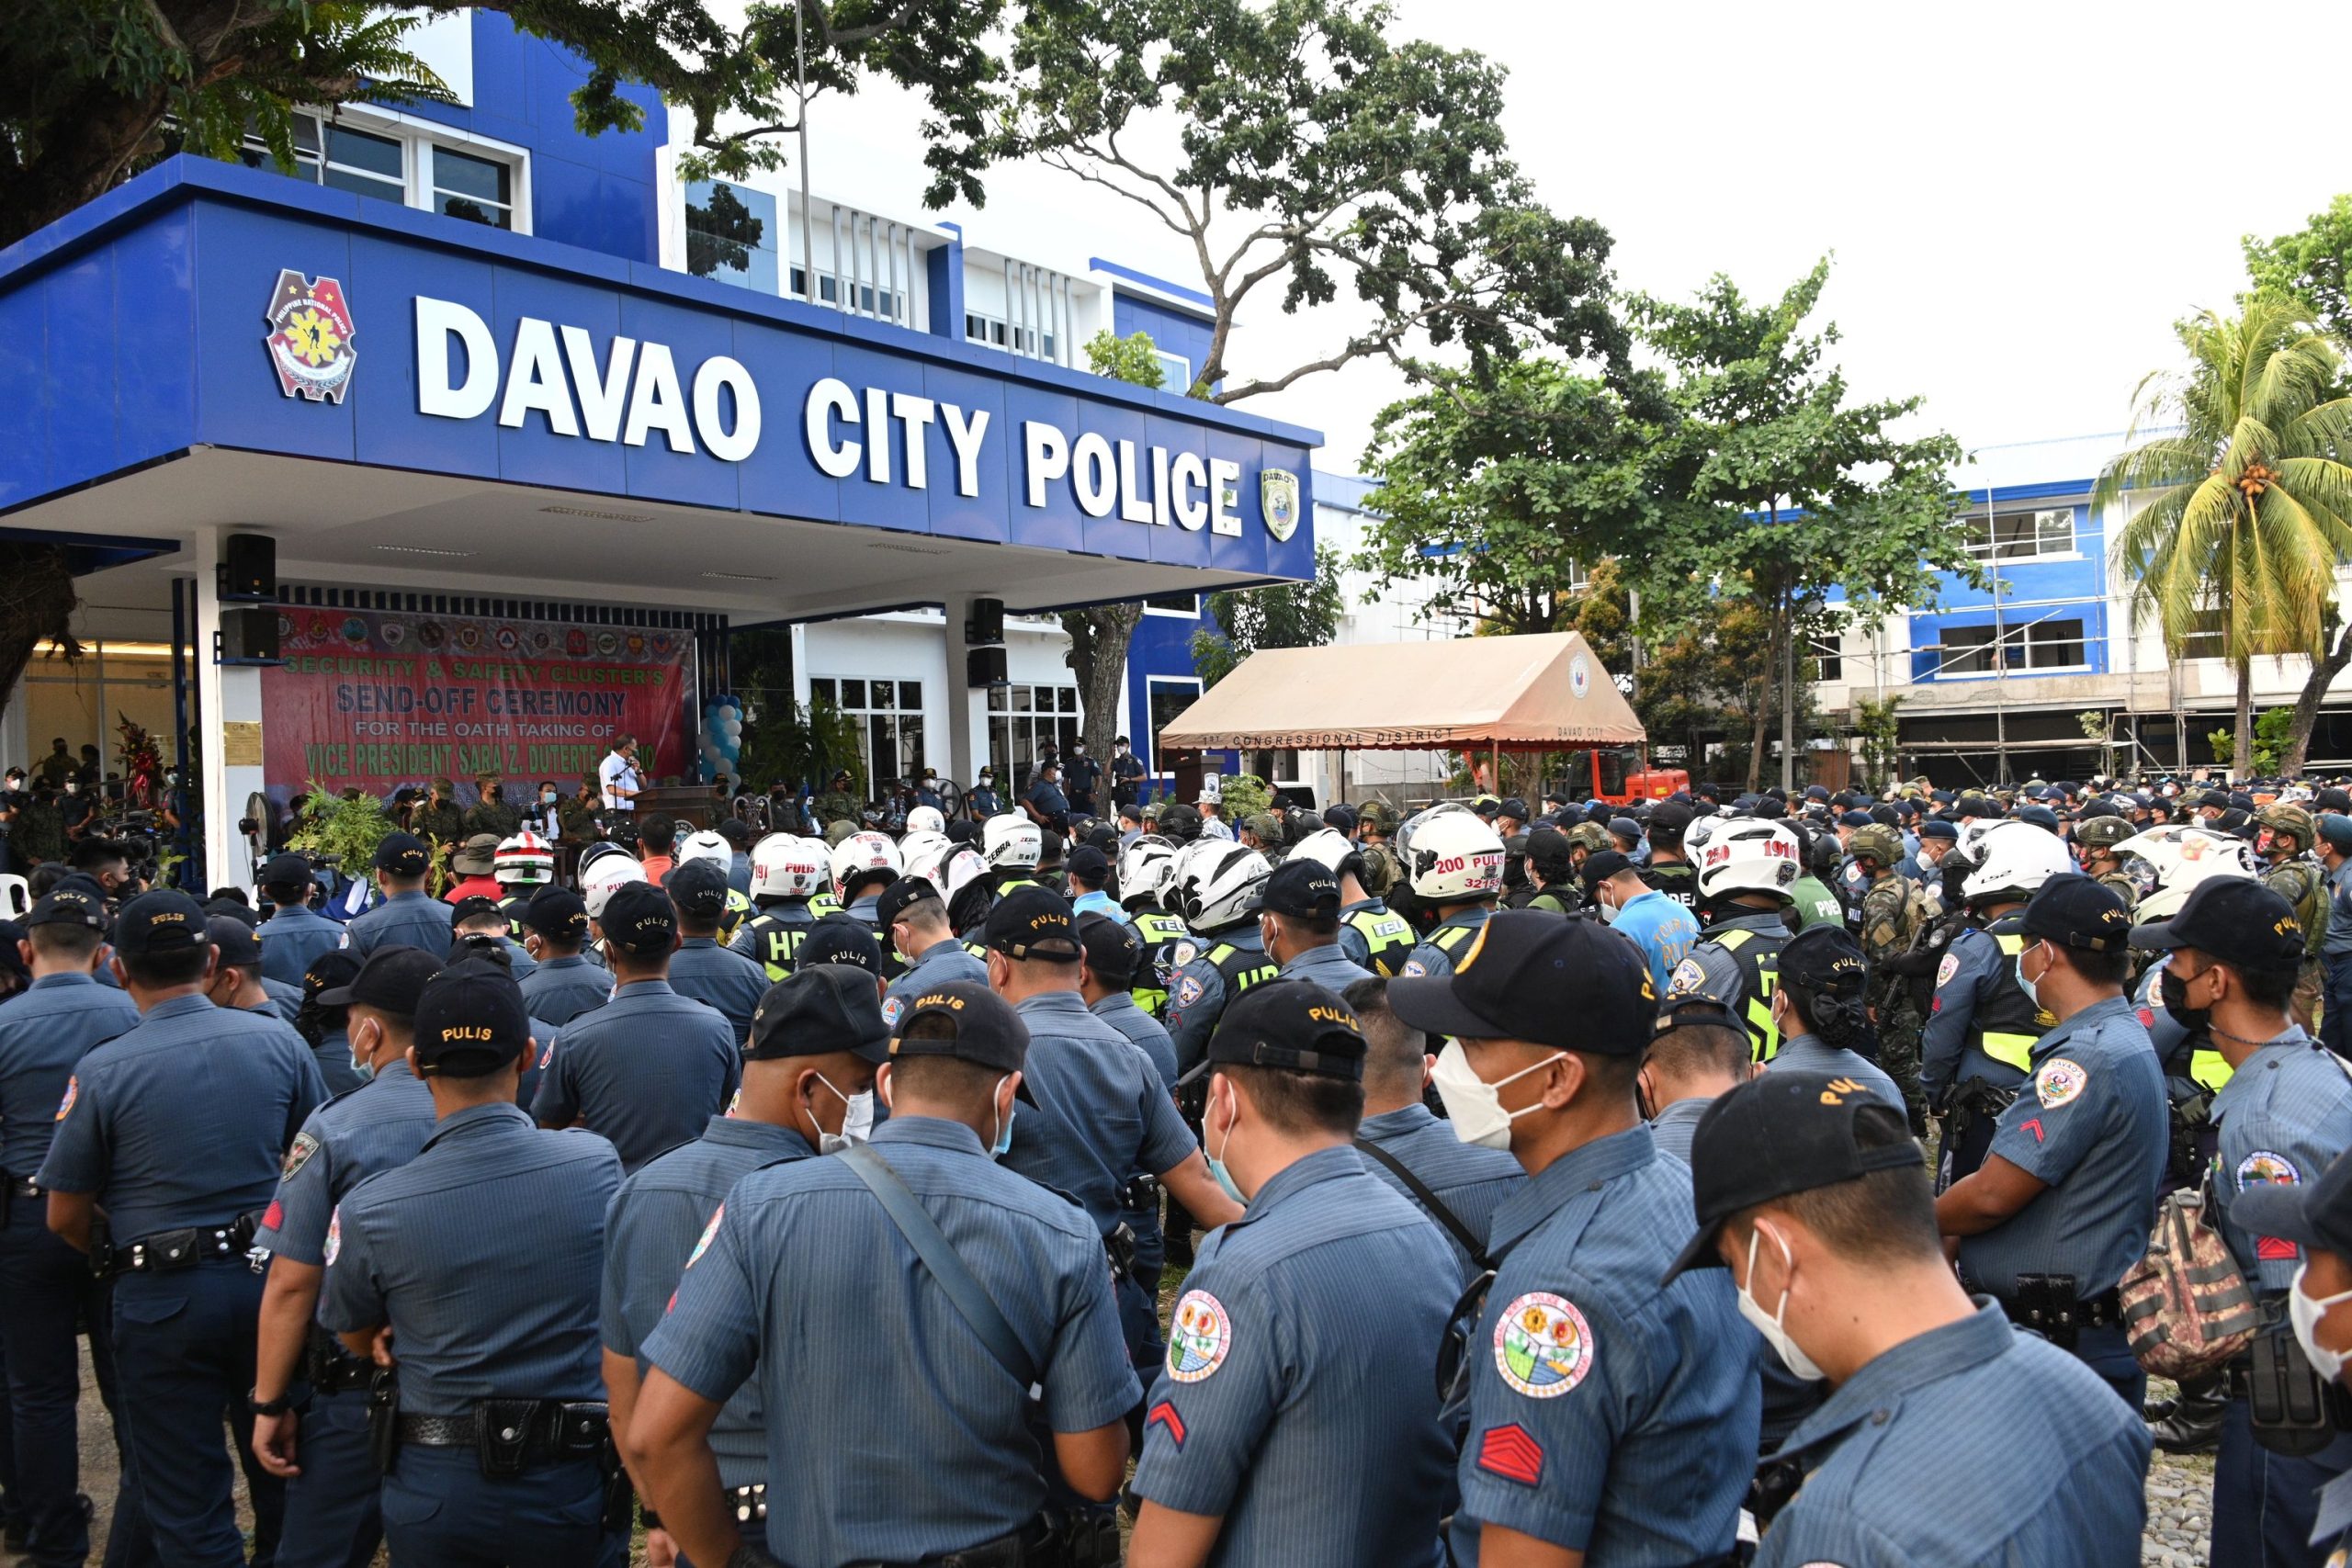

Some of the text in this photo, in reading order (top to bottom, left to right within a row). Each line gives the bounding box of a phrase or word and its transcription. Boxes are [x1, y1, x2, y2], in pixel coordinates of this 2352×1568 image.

[302, 299, 332, 316] NATIONAL
[331, 312, 348, 335] POLICE
[415, 295, 1242, 537] DAVAO CITY POLICE
[283, 655, 665, 686] SECURITY & SAFETY CLUSTER'S
[336, 682, 628, 717] SEND-OFF CEREMONY
[355, 721, 616, 737] FOR THE OATH TAKING OF
[1233, 734, 1363, 746] CONGRESSIONAL
[1376, 728, 1453, 742] DISTRICT
[1557, 727, 1603, 737] DAVAO CITY
[304, 742, 350, 777] VICE
[356, 743, 453, 776] PRESIDENT
[458, 743, 503, 775] SARA
[508, 743, 523, 775] Z.
[401, 850, 424, 859] PULIS
[987, 840, 1012, 865] ZEBRA
[1705, 844, 1731, 866] 250
[785, 863, 816, 874] PULIS
[1435, 854, 1504, 874] 200 PULIS
[1308, 879, 1337, 890] PULIS
[53, 892, 88, 904] PULIS
[696, 890, 723, 900] PULIS
[817, 897, 837, 906] TE
[150, 912, 186, 926] PULIS
[636, 917, 670, 931] PULIS
[1031, 914, 1069, 930] PULIS
[1374, 920, 1405, 936] TEU
[768, 931, 808, 961] HP
[831, 950, 867, 964] PULIS
[1831, 957, 1866, 973] PULIS
[916, 994, 965, 1010] PULIS
[1308, 1006, 1360, 1032] PULIS
[441, 1025, 492, 1043] PULIS
[1820, 1077, 1868, 1106] PUL
